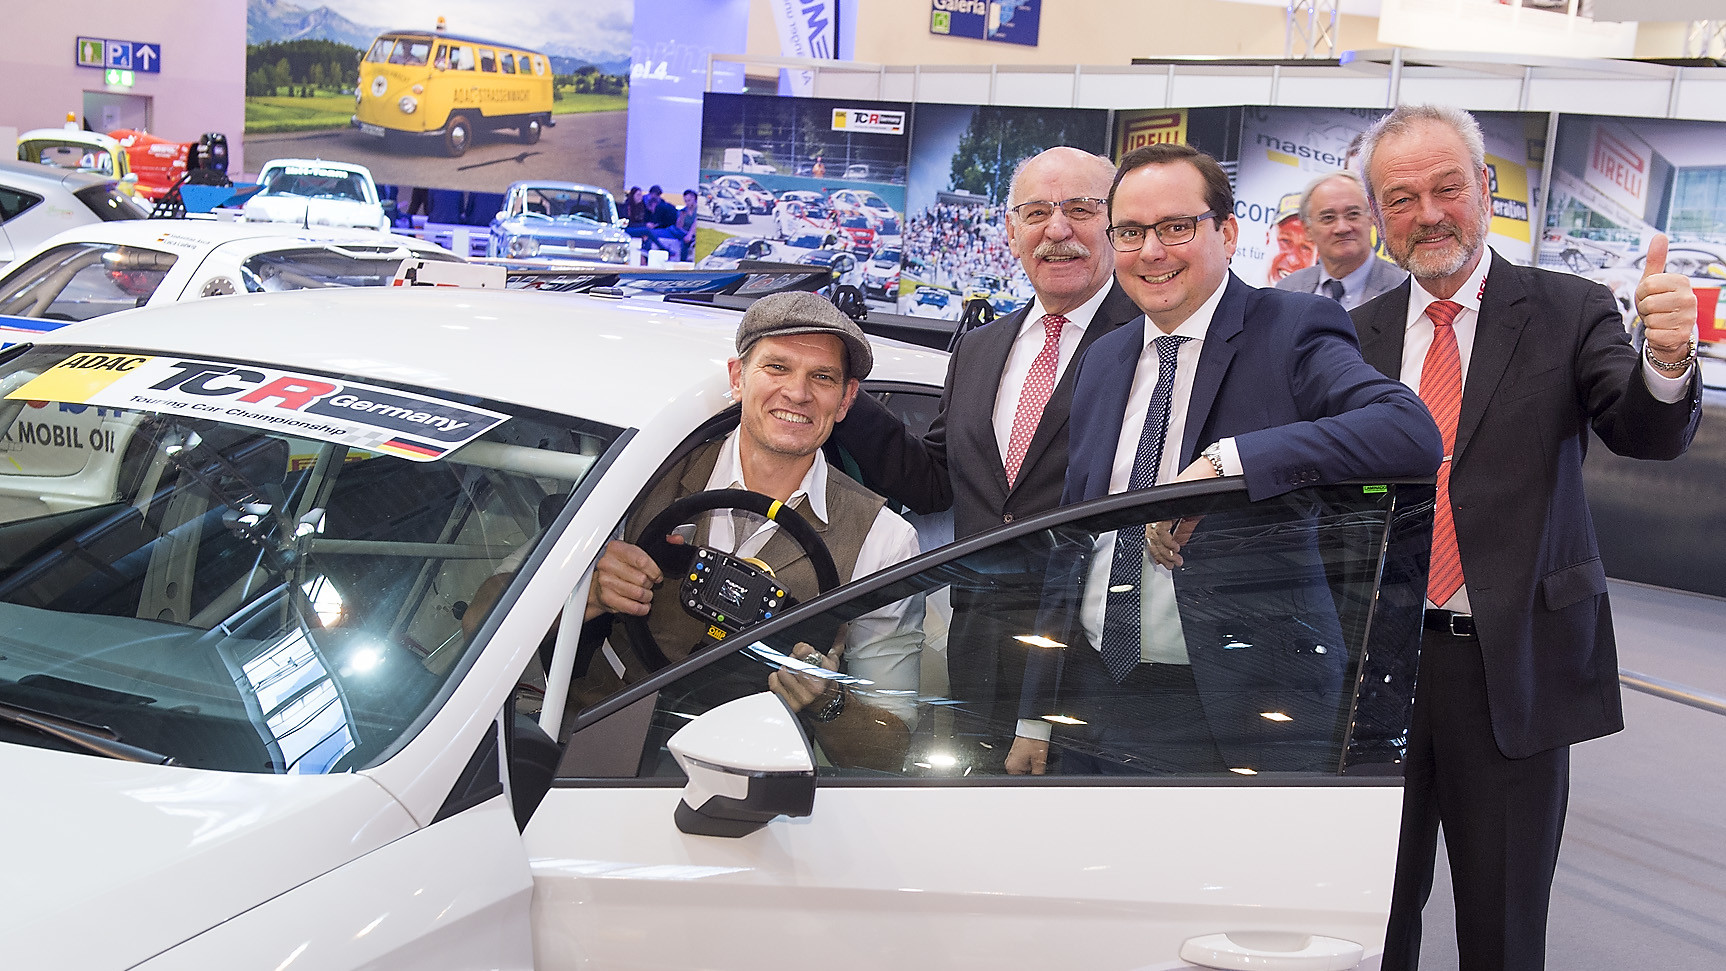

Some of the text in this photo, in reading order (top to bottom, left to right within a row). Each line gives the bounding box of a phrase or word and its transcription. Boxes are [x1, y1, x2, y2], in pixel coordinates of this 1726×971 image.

[854, 112, 879, 124] TCR
[1256, 133, 1345, 166] master
[1593, 124, 1645, 200] PIRELLI
[1492, 200, 1527, 220] eration
[1249, 246, 1265, 260] für
[58, 355, 147, 372] ADAC
[148, 361, 337, 411] TCR
[328, 395, 469, 432] Germany
[129, 395, 188, 410] Touring
[191, 403, 225, 413] Car
[225, 408, 347, 436] Championship
[18, 420, 115, 454] MOBIL OIL
[708, 627, 727, 639] OMP
